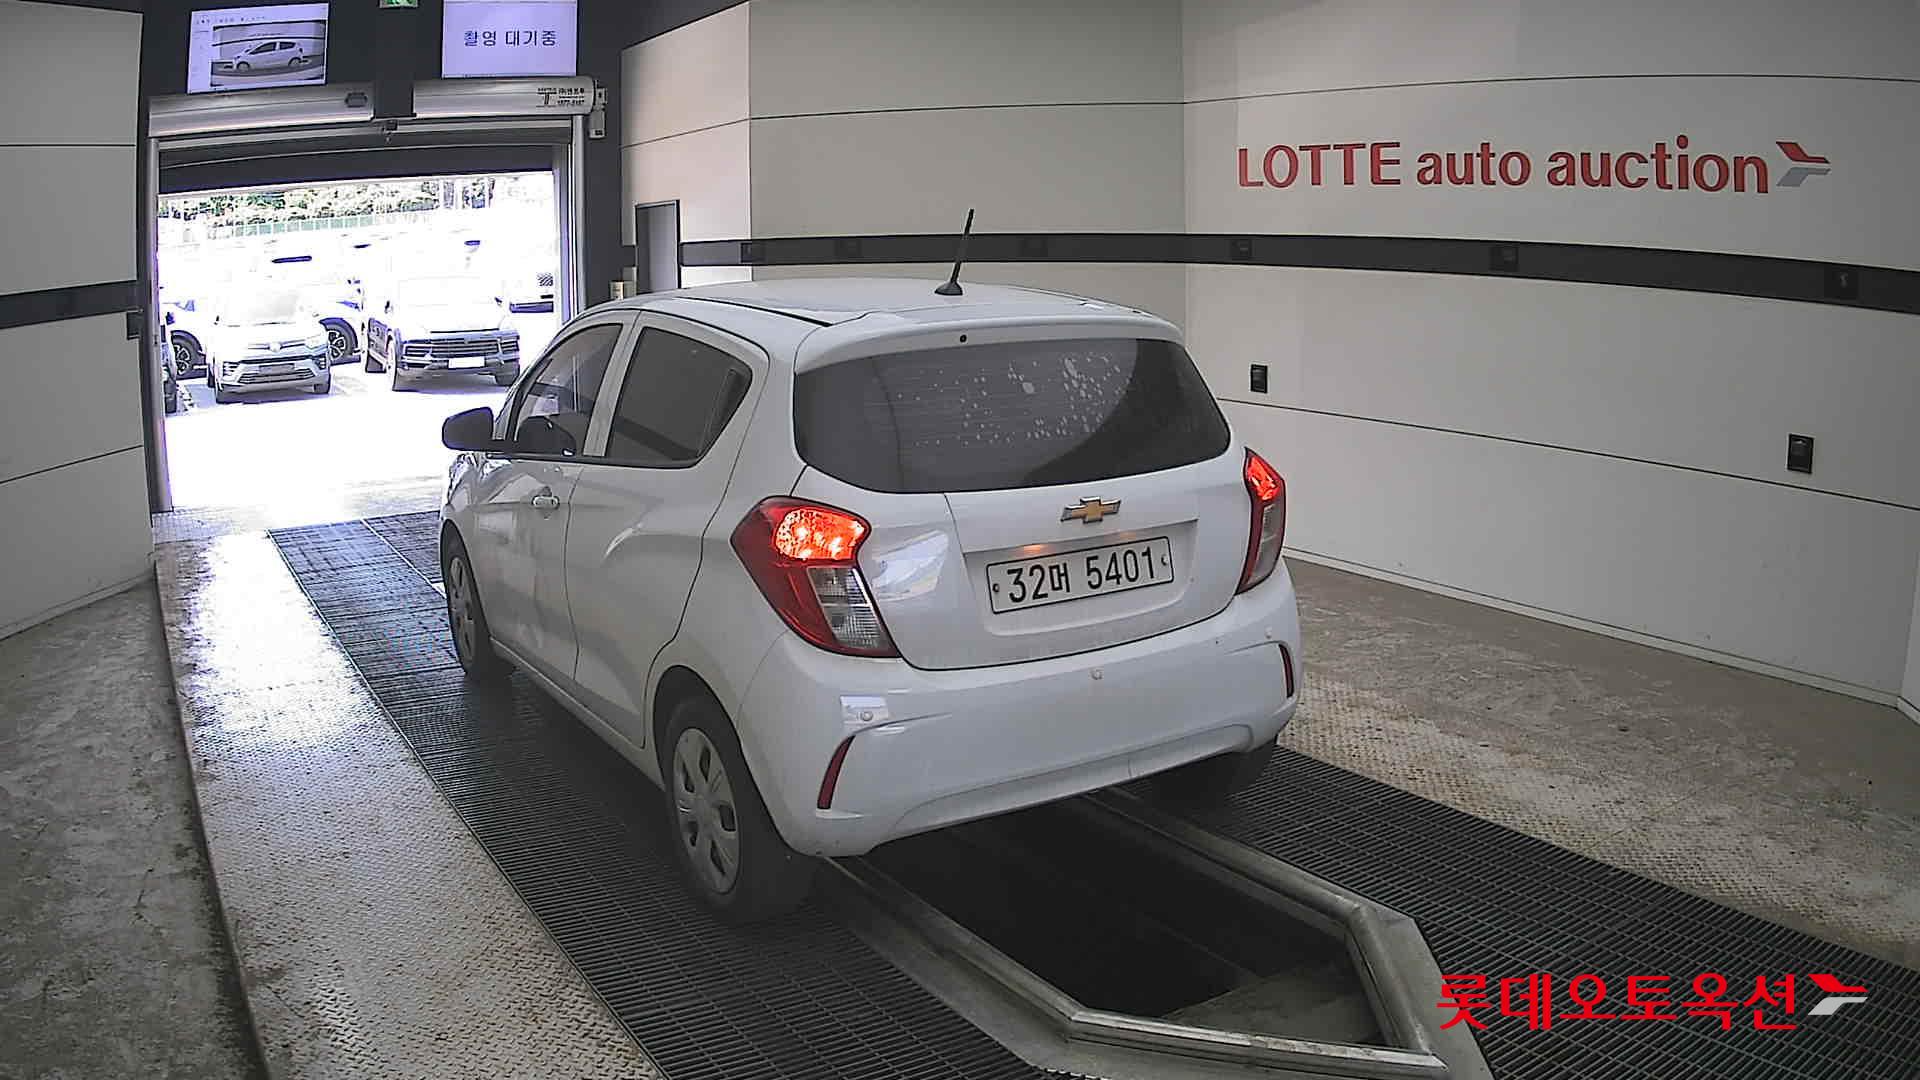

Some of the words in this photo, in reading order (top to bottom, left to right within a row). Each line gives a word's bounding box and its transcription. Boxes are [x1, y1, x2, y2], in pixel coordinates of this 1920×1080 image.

[505, 28, 558, 48] 대기중
[1237, 142, 1402, 189] LOTTE
[1416, 141, 1533, 187] auto
[1547, 135, 1770, 194] auction
[1006, 561, 1072, 603] 32머
[1085, 545, 1156, 591] 5401
